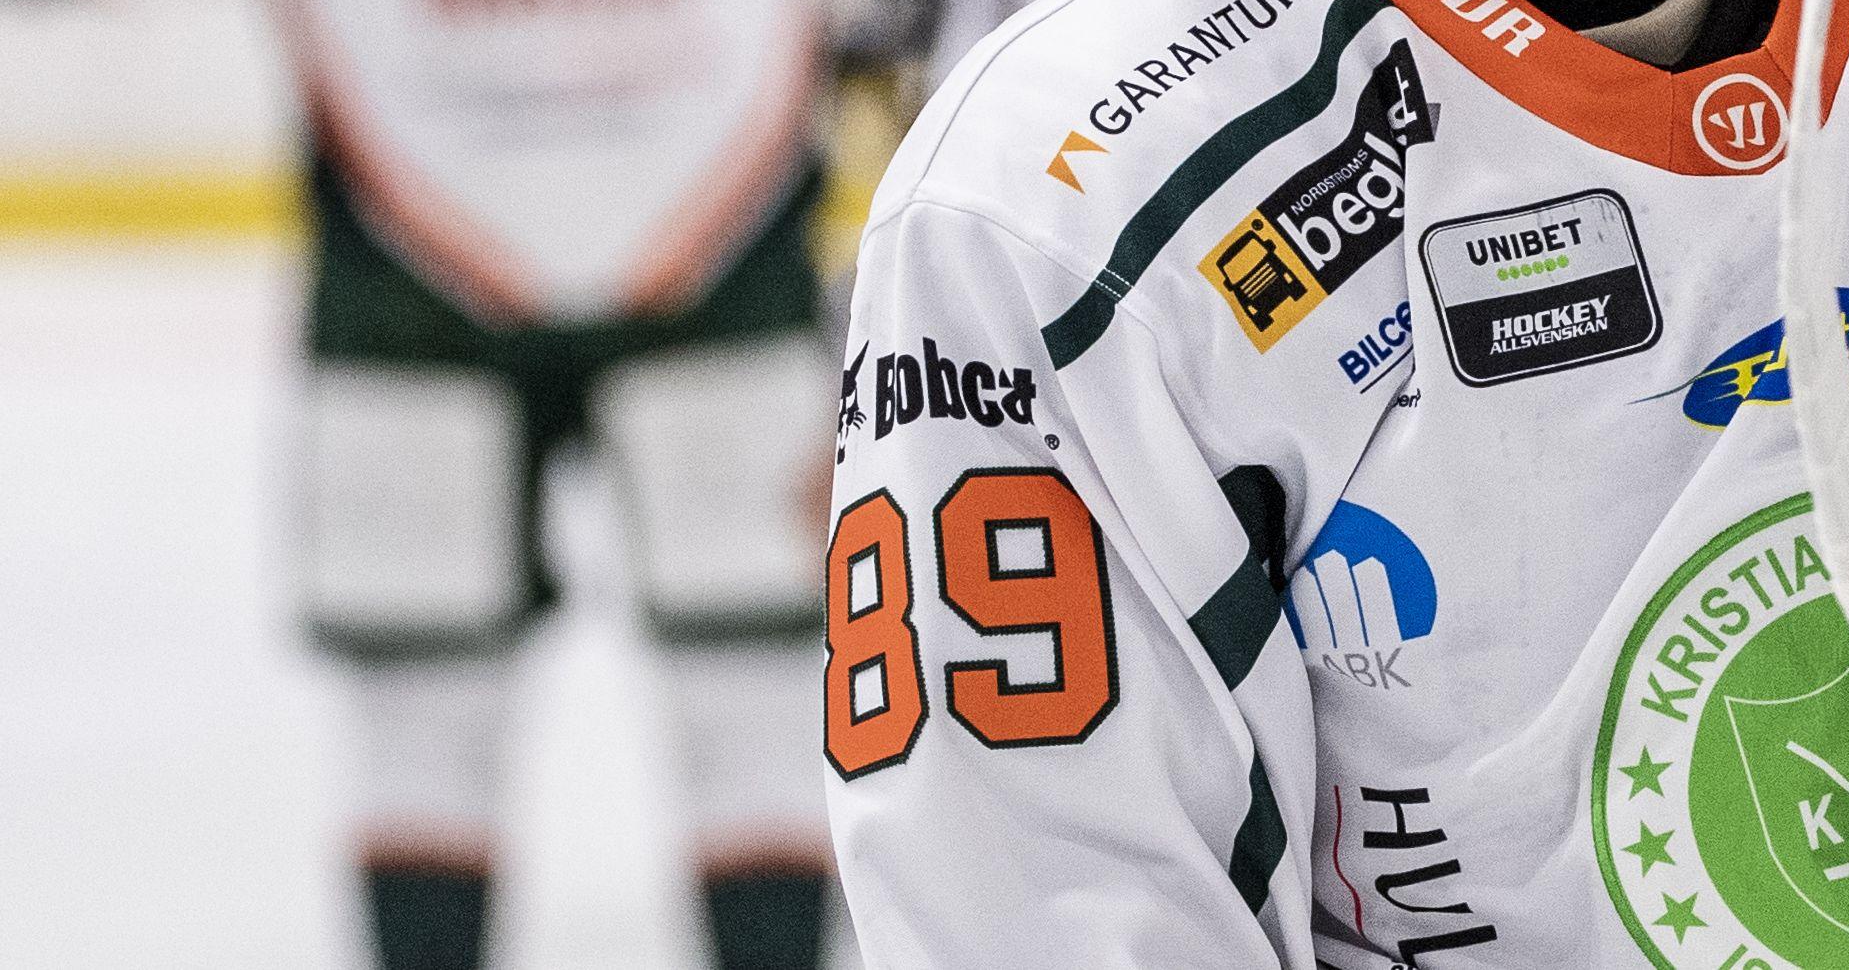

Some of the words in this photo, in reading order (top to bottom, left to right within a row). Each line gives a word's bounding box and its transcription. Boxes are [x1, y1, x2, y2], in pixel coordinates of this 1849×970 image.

[1467, 217, 1587, 268] UNIBET
[1488, 316, 1609, 356] ALLSVENSKAN
[1490, 293, 1612, 341] HOCKEY
[822, 465, 1121, 784] 89
